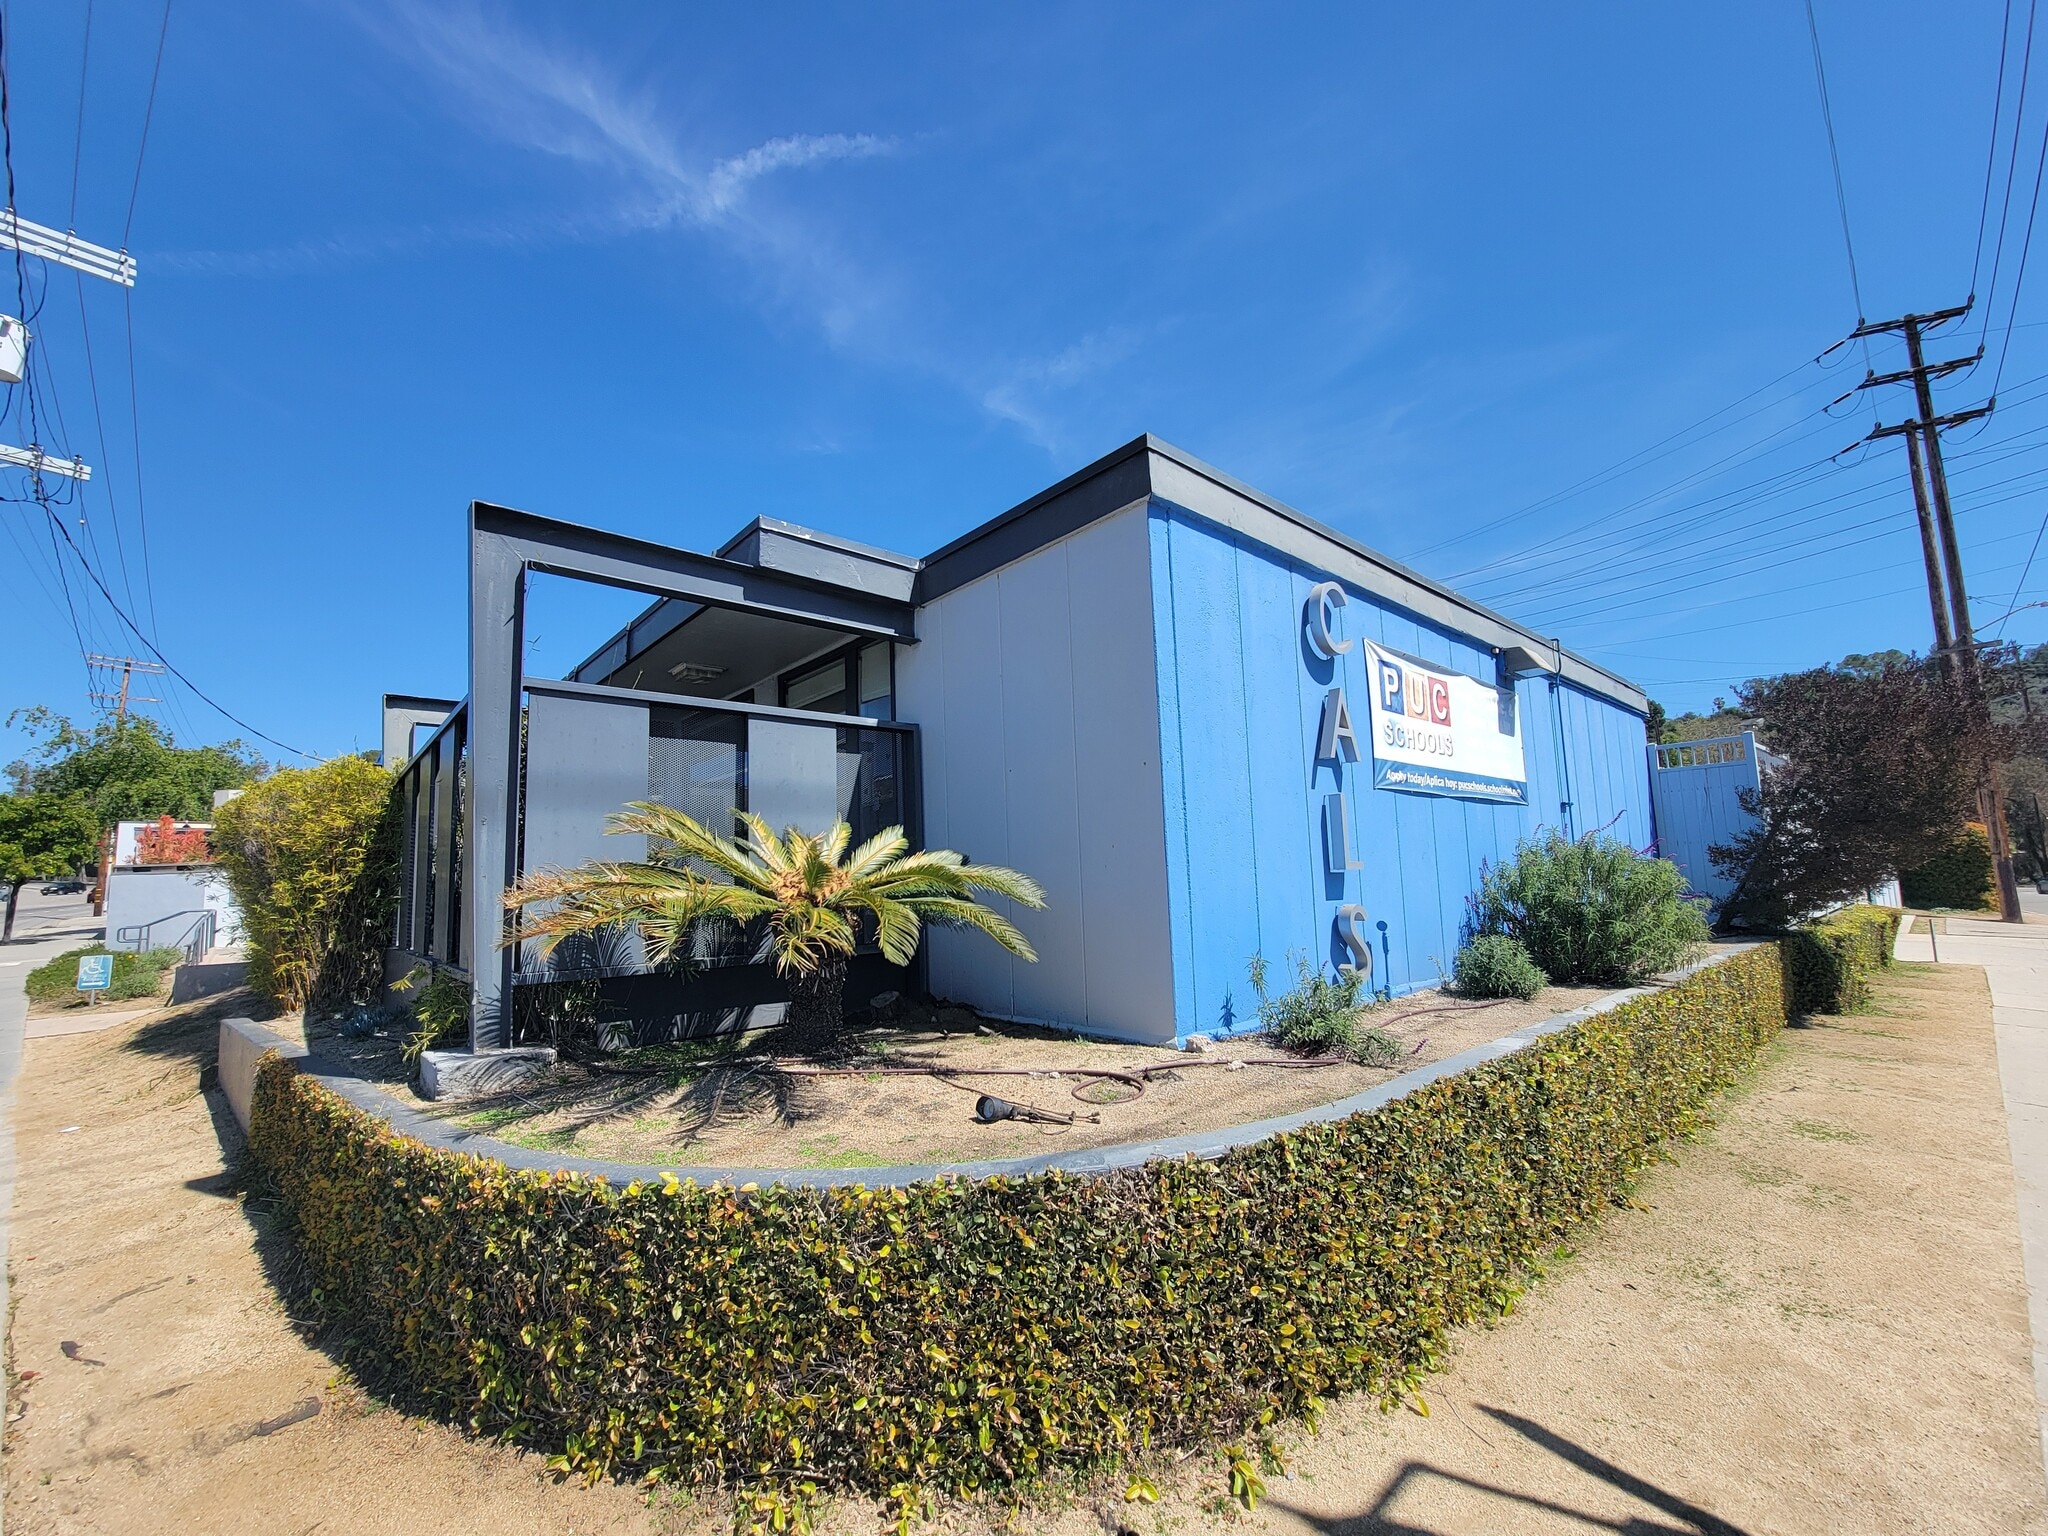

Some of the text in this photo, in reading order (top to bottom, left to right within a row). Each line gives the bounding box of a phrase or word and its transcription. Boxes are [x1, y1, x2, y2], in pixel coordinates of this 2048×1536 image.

[1381, 663, 1449, 722] PUC
[1383, 719, 1454, 757] SCHOOLS
[1308, 580, 1373, 982] CALS
[1386, 769, 1407, 784] Apply
